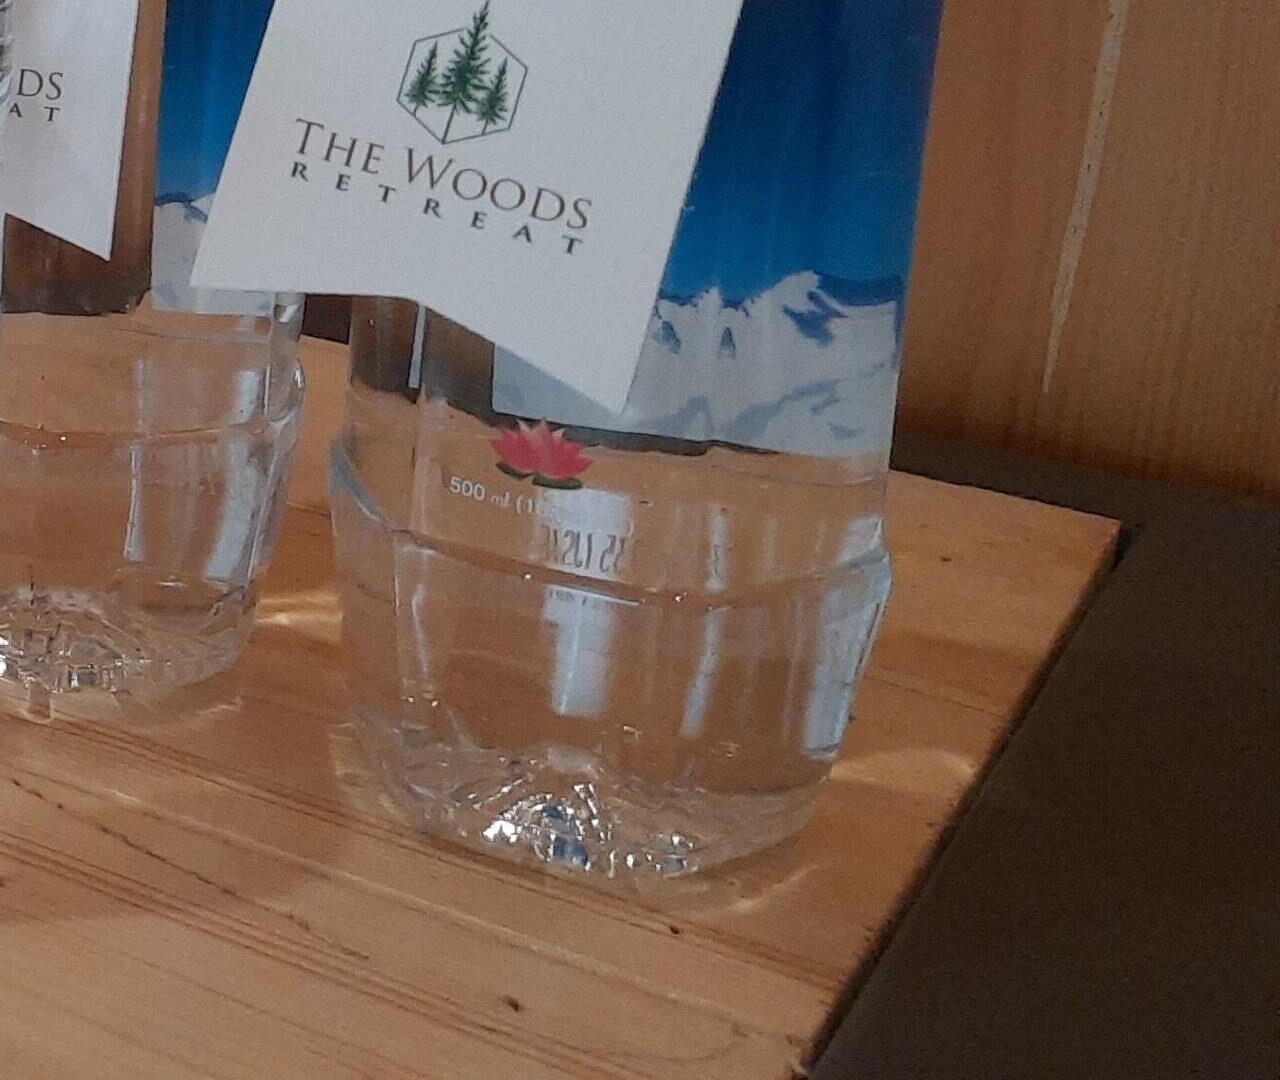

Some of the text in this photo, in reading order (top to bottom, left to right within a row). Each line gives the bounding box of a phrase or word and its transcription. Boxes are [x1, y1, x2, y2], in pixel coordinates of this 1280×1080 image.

[290, 161, 584, 256] RETREAT
[294, 117, 593, 231] THE WOODS
[449, 475, 486, 502] 500
